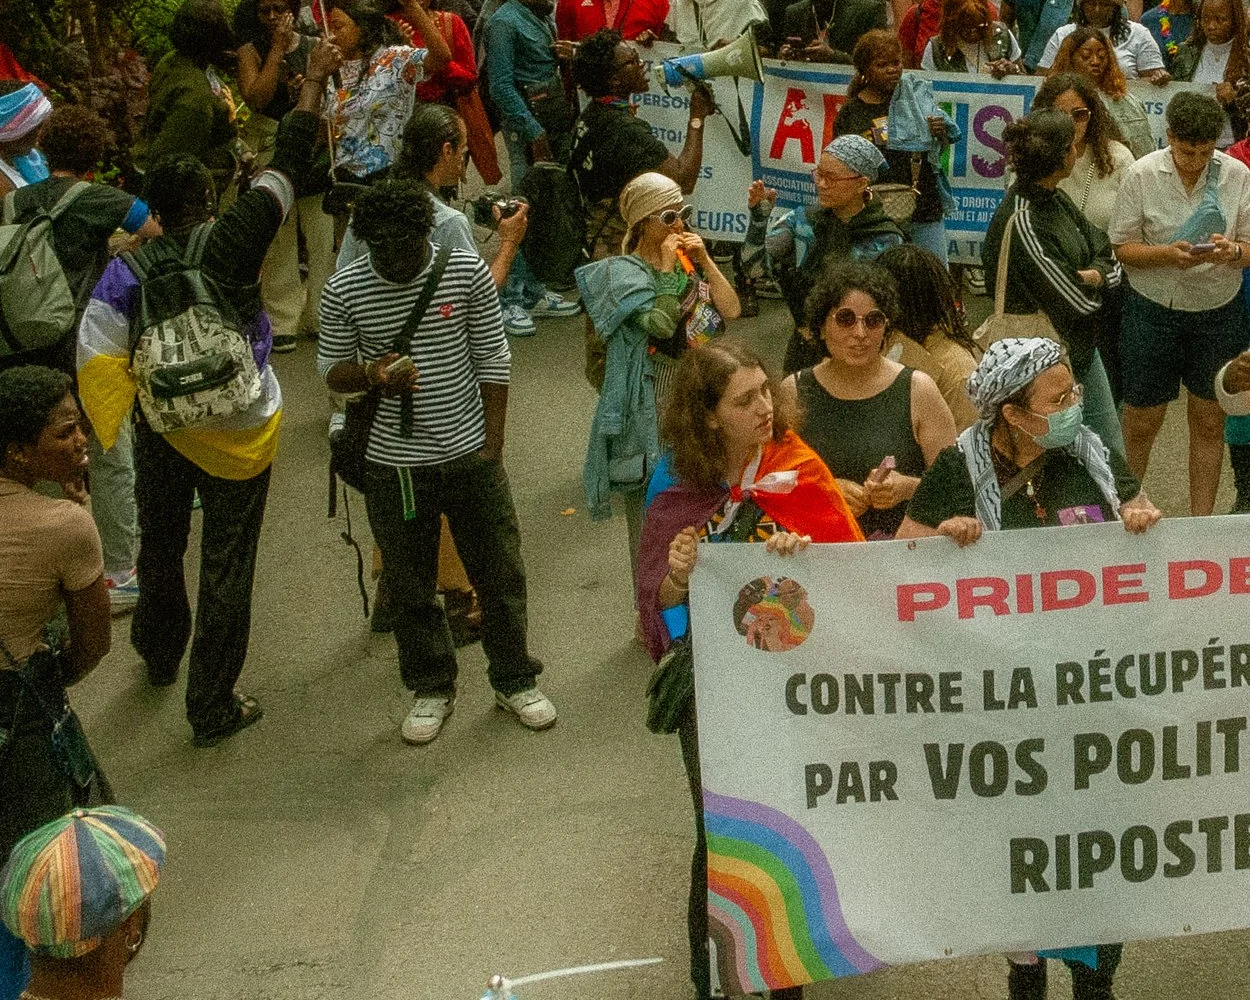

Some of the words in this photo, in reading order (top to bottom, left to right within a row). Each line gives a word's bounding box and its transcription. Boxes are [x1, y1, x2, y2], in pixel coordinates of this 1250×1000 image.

[962, 195, 997, 210] DROITS
[965, 210, 977, 222] ET
[896, 562, 1149, 622] PRIDE
[786, 671, 963, 715] CONTRE
[983, 668, 1037, 711] LA
[805, 760, 898, 808] PAR
[924, 738, 1048, 799] VOS
